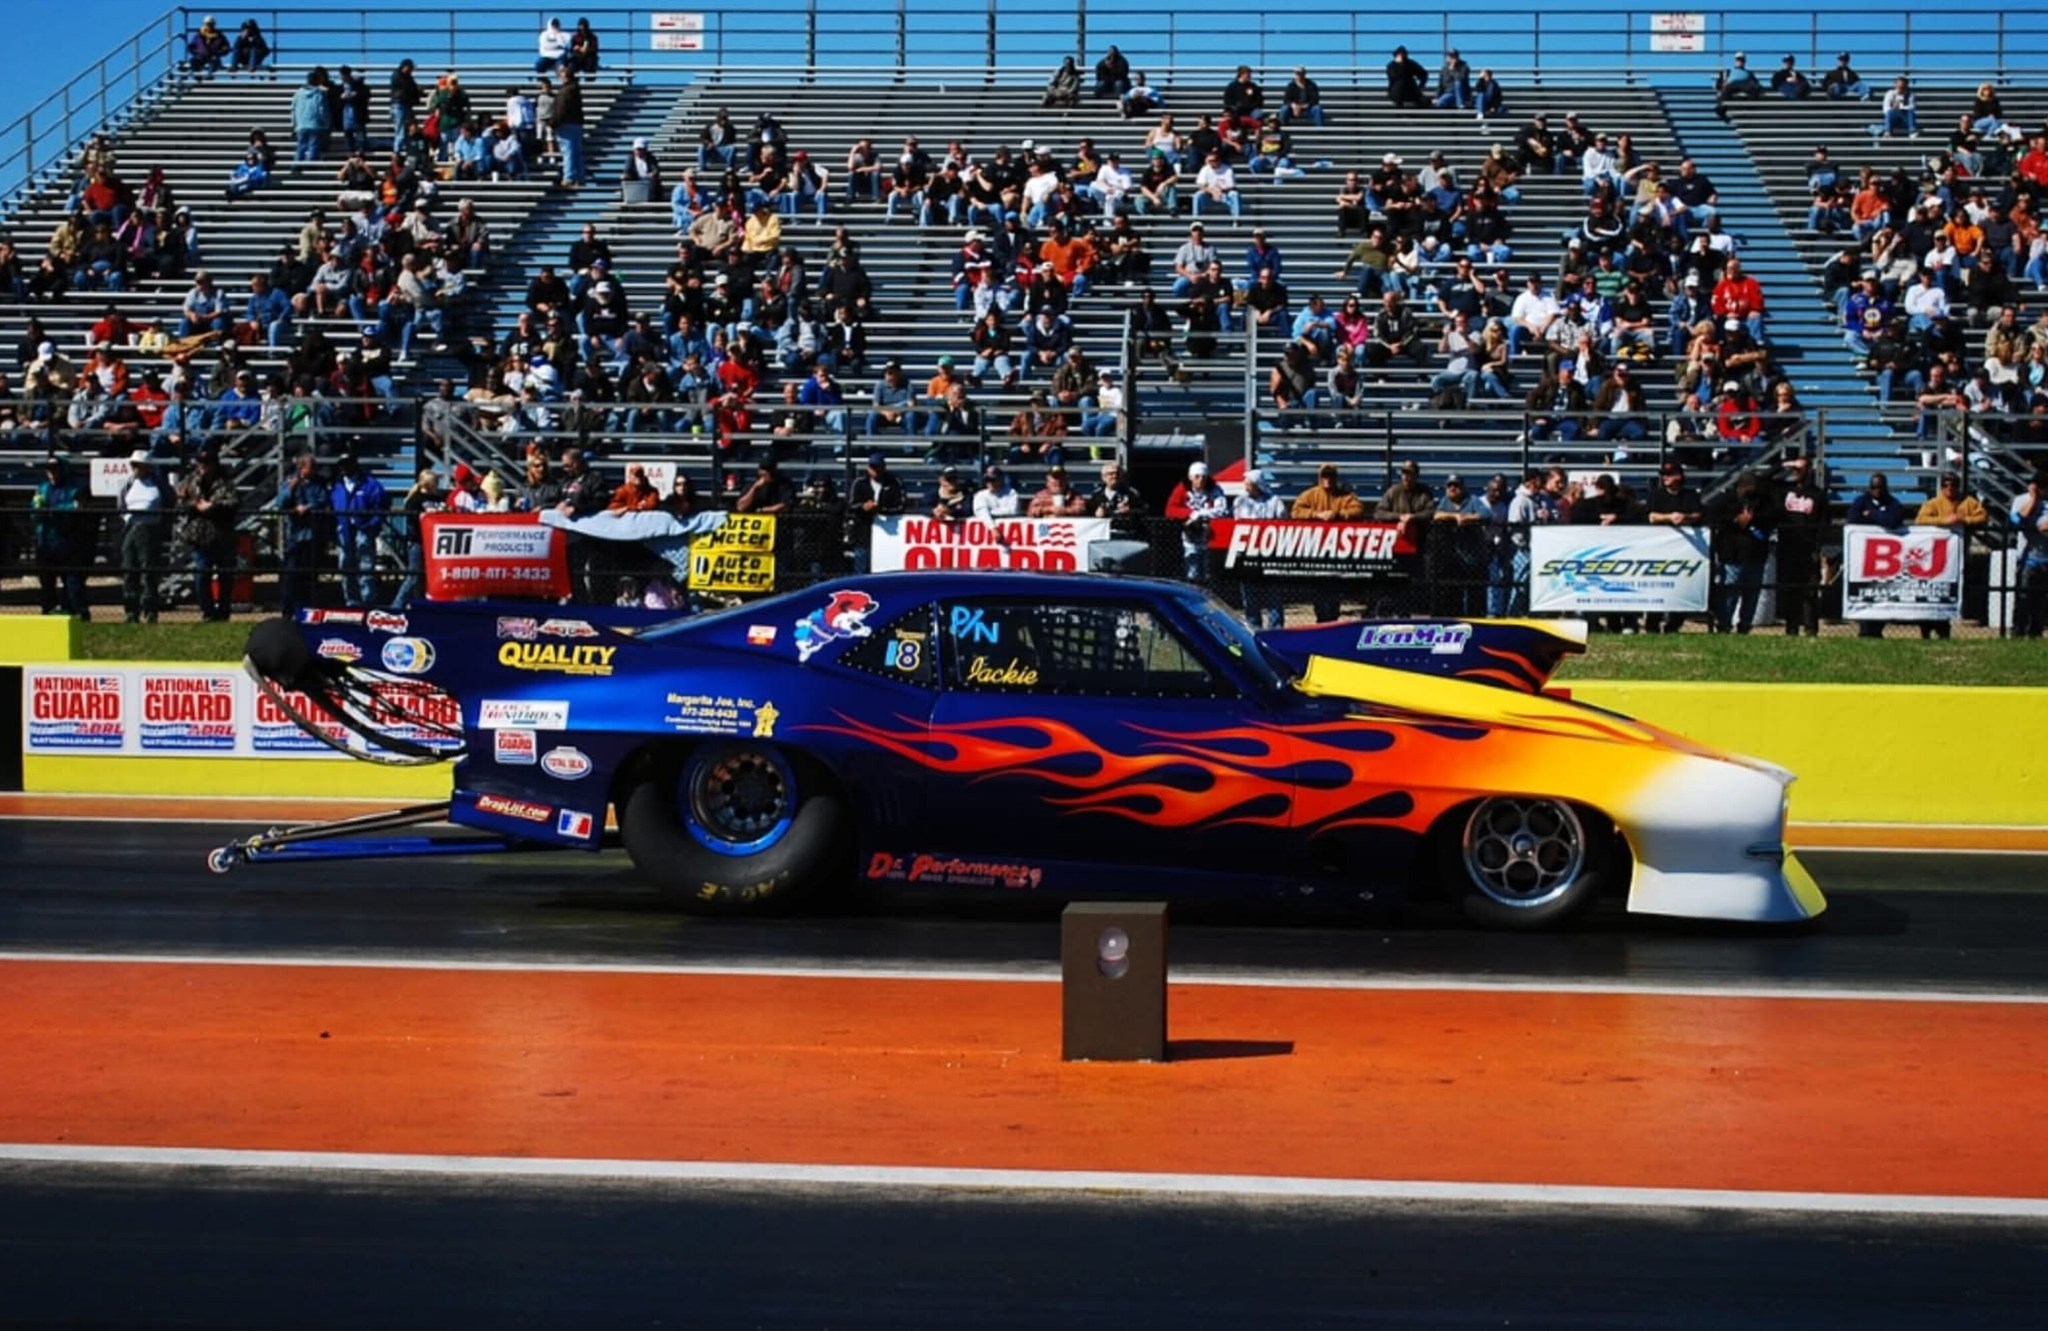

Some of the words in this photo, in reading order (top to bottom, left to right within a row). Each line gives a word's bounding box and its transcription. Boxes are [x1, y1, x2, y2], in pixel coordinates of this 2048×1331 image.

[719, 515, 762, 530] uto
[475, 530, 547, 541] PERFORMANCE
[709, 532, 771, 547] Meter
[905, 520, 1037, 546] NATIONAL
[436, 528, 473, 555] ATI
[484, 543, 535, 553] PRODUCTS
[1224, 524, 1397, 569] FLOWMASTER
[715, 555, 761, 570] Auto
[1538, 559, 1702, 578] SPEEDTECH
[439, 566, 551, 581] 1-800-ATI-3433
[709, 569, 771, 585] Meter
[498, 641, 616, 666] QUALITY
[967, 656, 1038, 685] Jackie
[34, 677, 99, 691] NATIONAL
[145, 678, 210, 693] NATIONAL
[34, 692, 120, 720] GUARD
[145, 693, 232, 722] GUARD
[498, 739, 533, 750] GUARD
